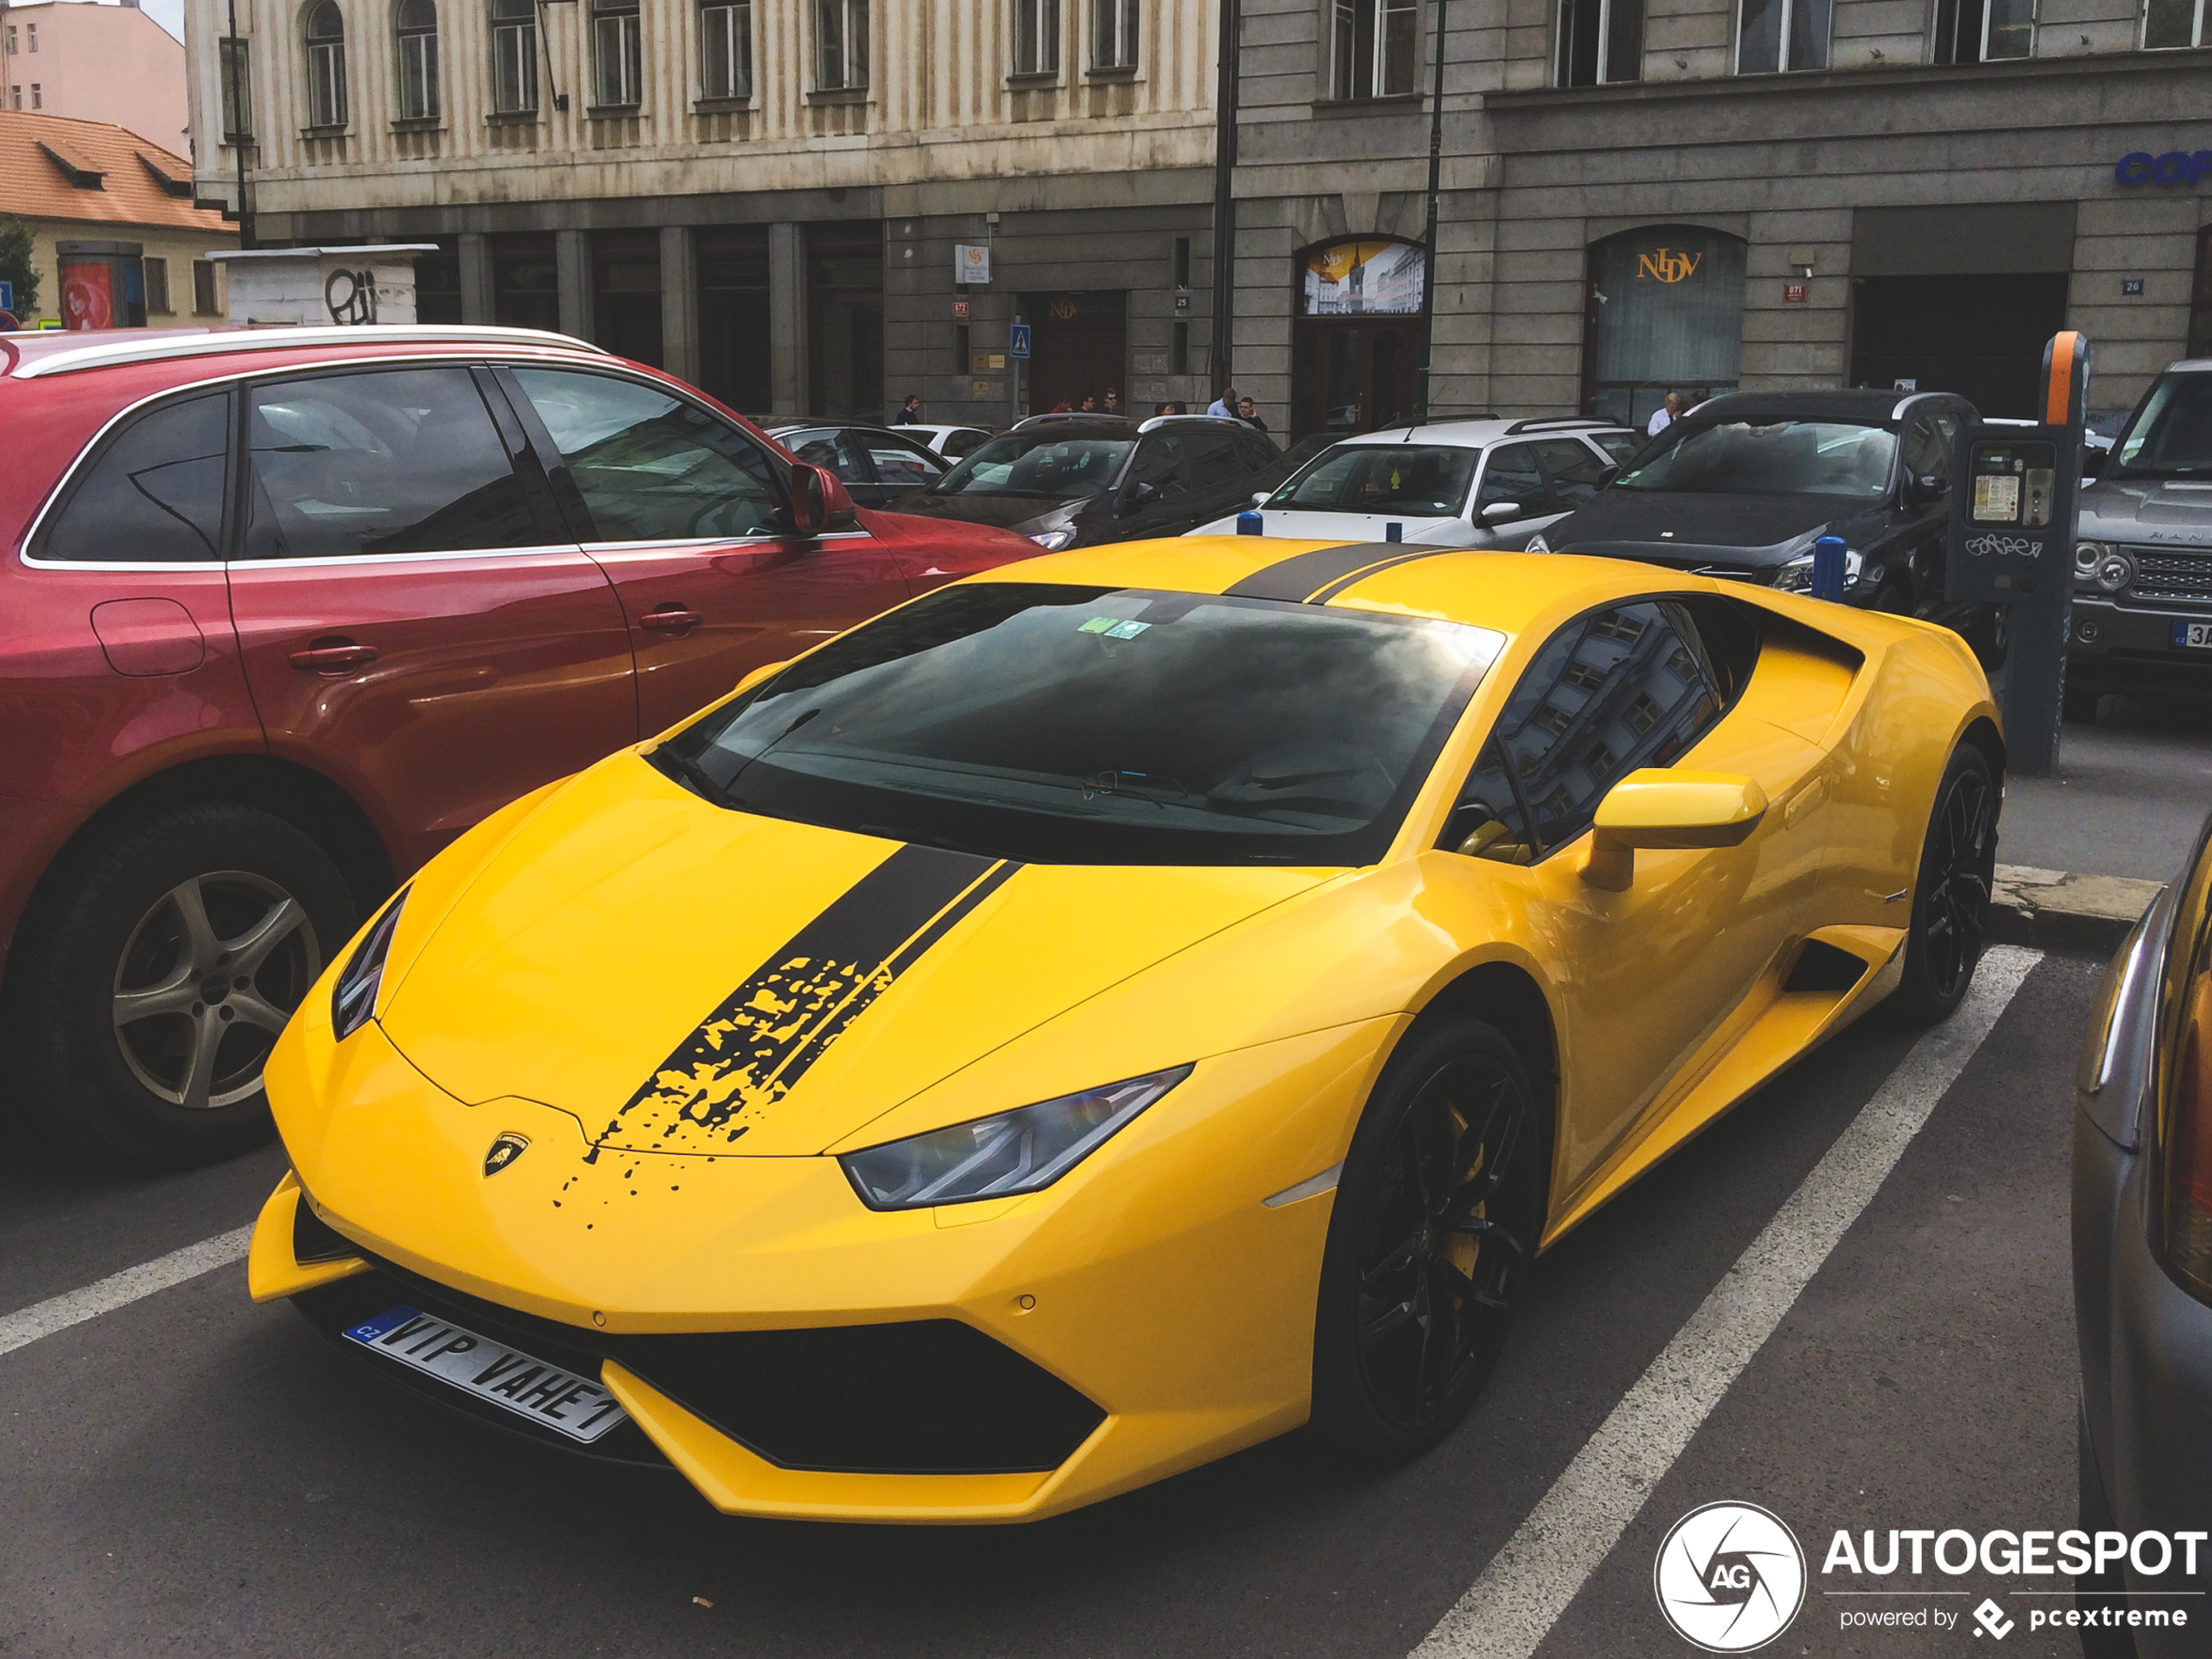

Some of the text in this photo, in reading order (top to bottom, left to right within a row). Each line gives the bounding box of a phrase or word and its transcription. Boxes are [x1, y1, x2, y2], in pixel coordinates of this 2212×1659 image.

[2127, 281, 2140, 292] 26
[2149, 531, 2212, 541] RAN
[356, 1325, 381, 1339] CZ
[381, 1316, 478, 1363] VIP
